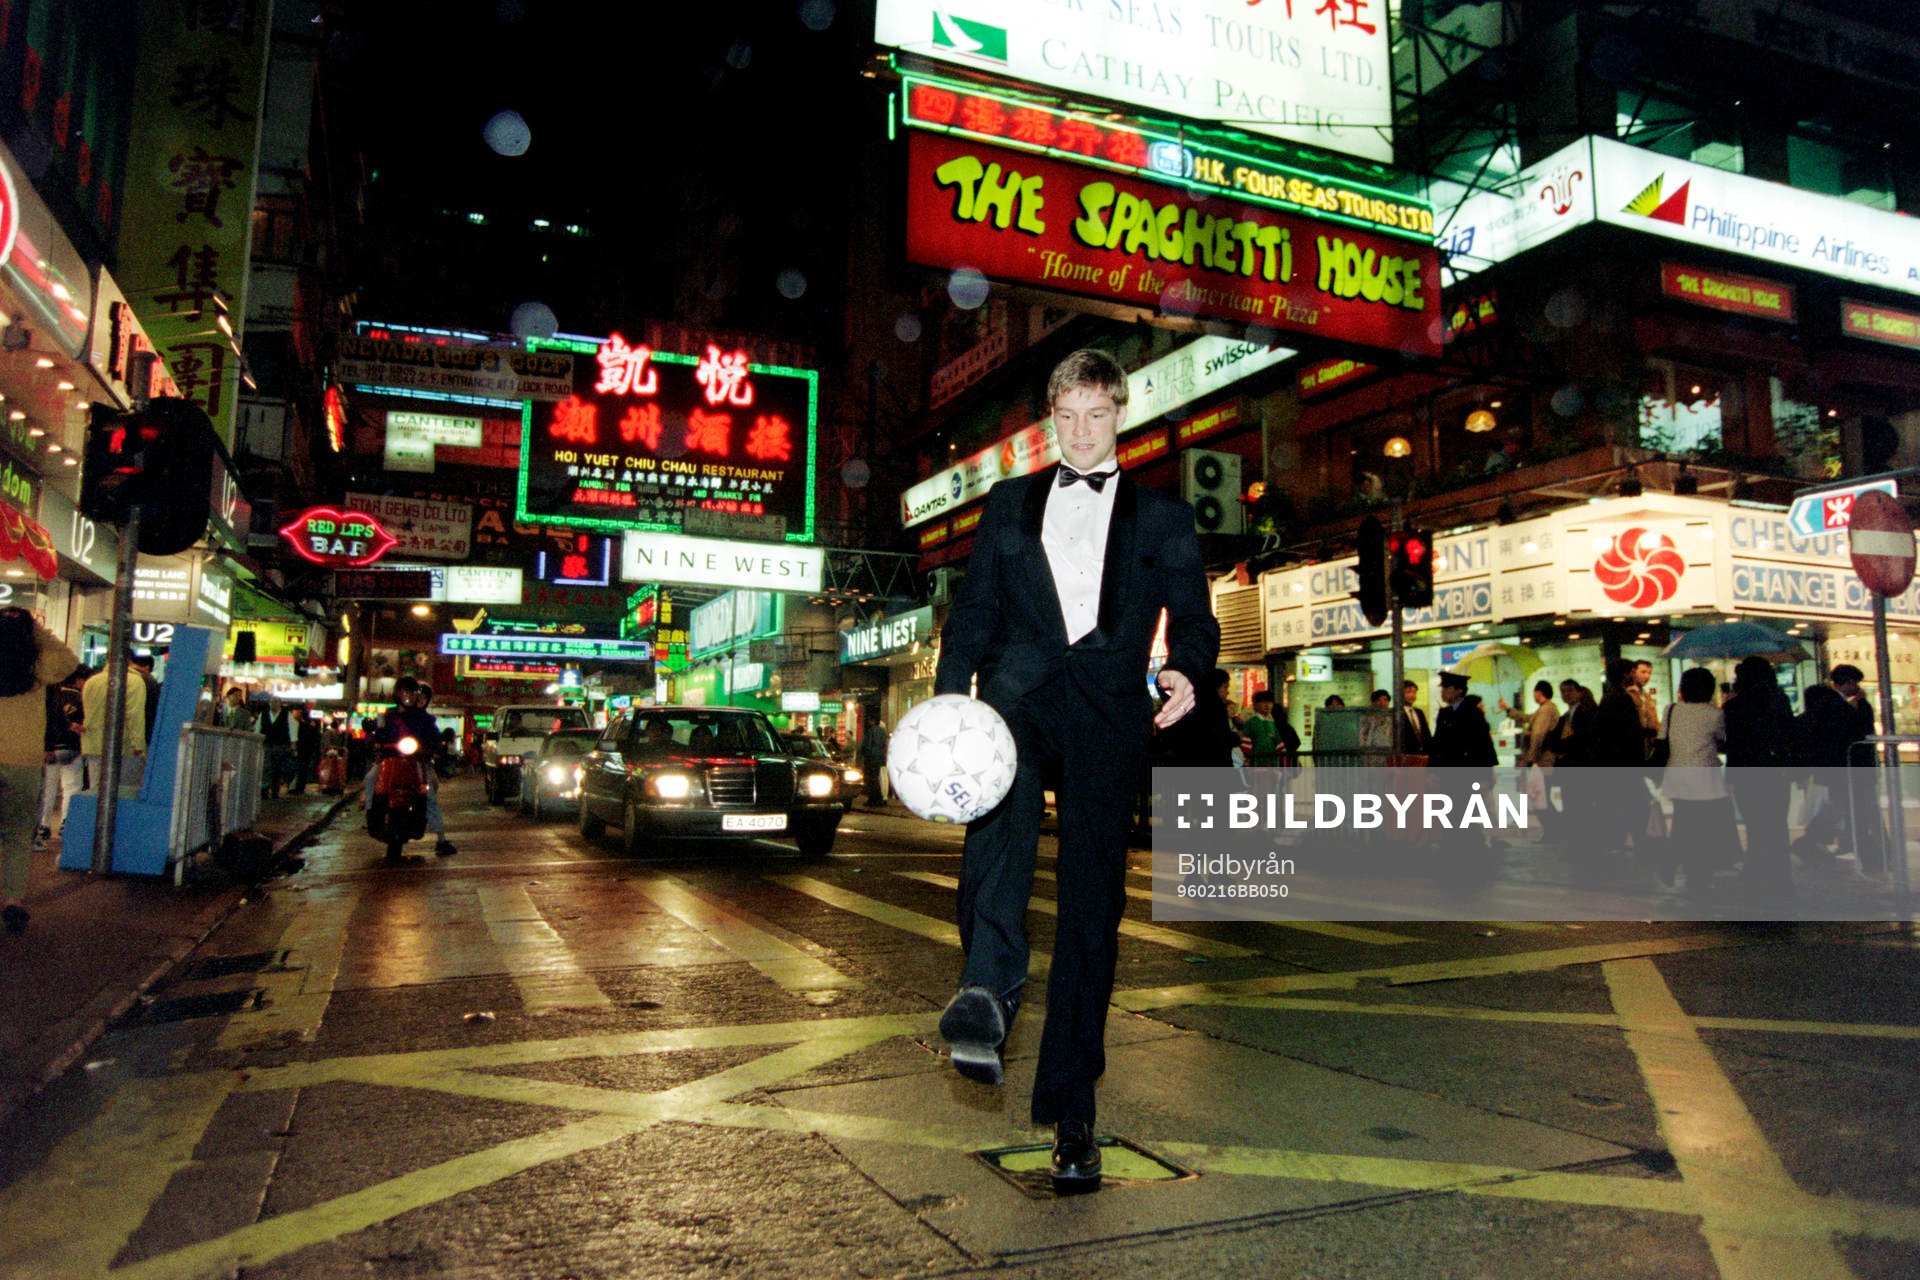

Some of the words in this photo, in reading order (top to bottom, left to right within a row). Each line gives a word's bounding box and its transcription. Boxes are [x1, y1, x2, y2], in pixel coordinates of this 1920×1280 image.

[1204, 13, 1301, 70] TOURS
[1041, 37, 1193, 101] CATHAY
[1214, 78, 1345, 138] PACIFIC
[1233, 166, 1286, 201] FOUR
[1286, 178, 1339, 212] SEAS
[1337, 190, 1398, 225] TOURS
[936, 155, 1046, 235] THE
[1315, 235, 1425, 311] HOUSE
[1691, 204, 1800, 255] Philippine
[1812, 235, 1891, 275] Airlines
[1109, 263, 1133, 294] of
[1138, 270, 1166, 295] the
[1167, 278, 1263, 315] American
[394, 413, 477, 430] CANTEEN
[0, 461, 32, 505] dom
[554, 450, 577, 464] HOI
[583, 453, 619, 468] YUET
[624, 456, 656, 471] CHIU
[661, 460, 697, 475] CHAU
[702, 463, 785, 482] RESTAURANT
[385, 500, 420, 517] GEMS
[913, 493, 947, 519] QANTAS
[71, 510, 96, 566] U2
[307, 518, 336, 535] RED
[340, 522, 377, 539] LIPS
[636, 546, 718, 571] NINE
[734, 554, 810, 579] WEST
[1734, 568, 1838, 609] CHANGE
[134, 622, 175, 644] U2
[848, 627, 879, 657] NINE
[881, 616, 918, 650] WEST
[726, 817, 743, 828] EA
[748, 816, 785, 828] 4070
